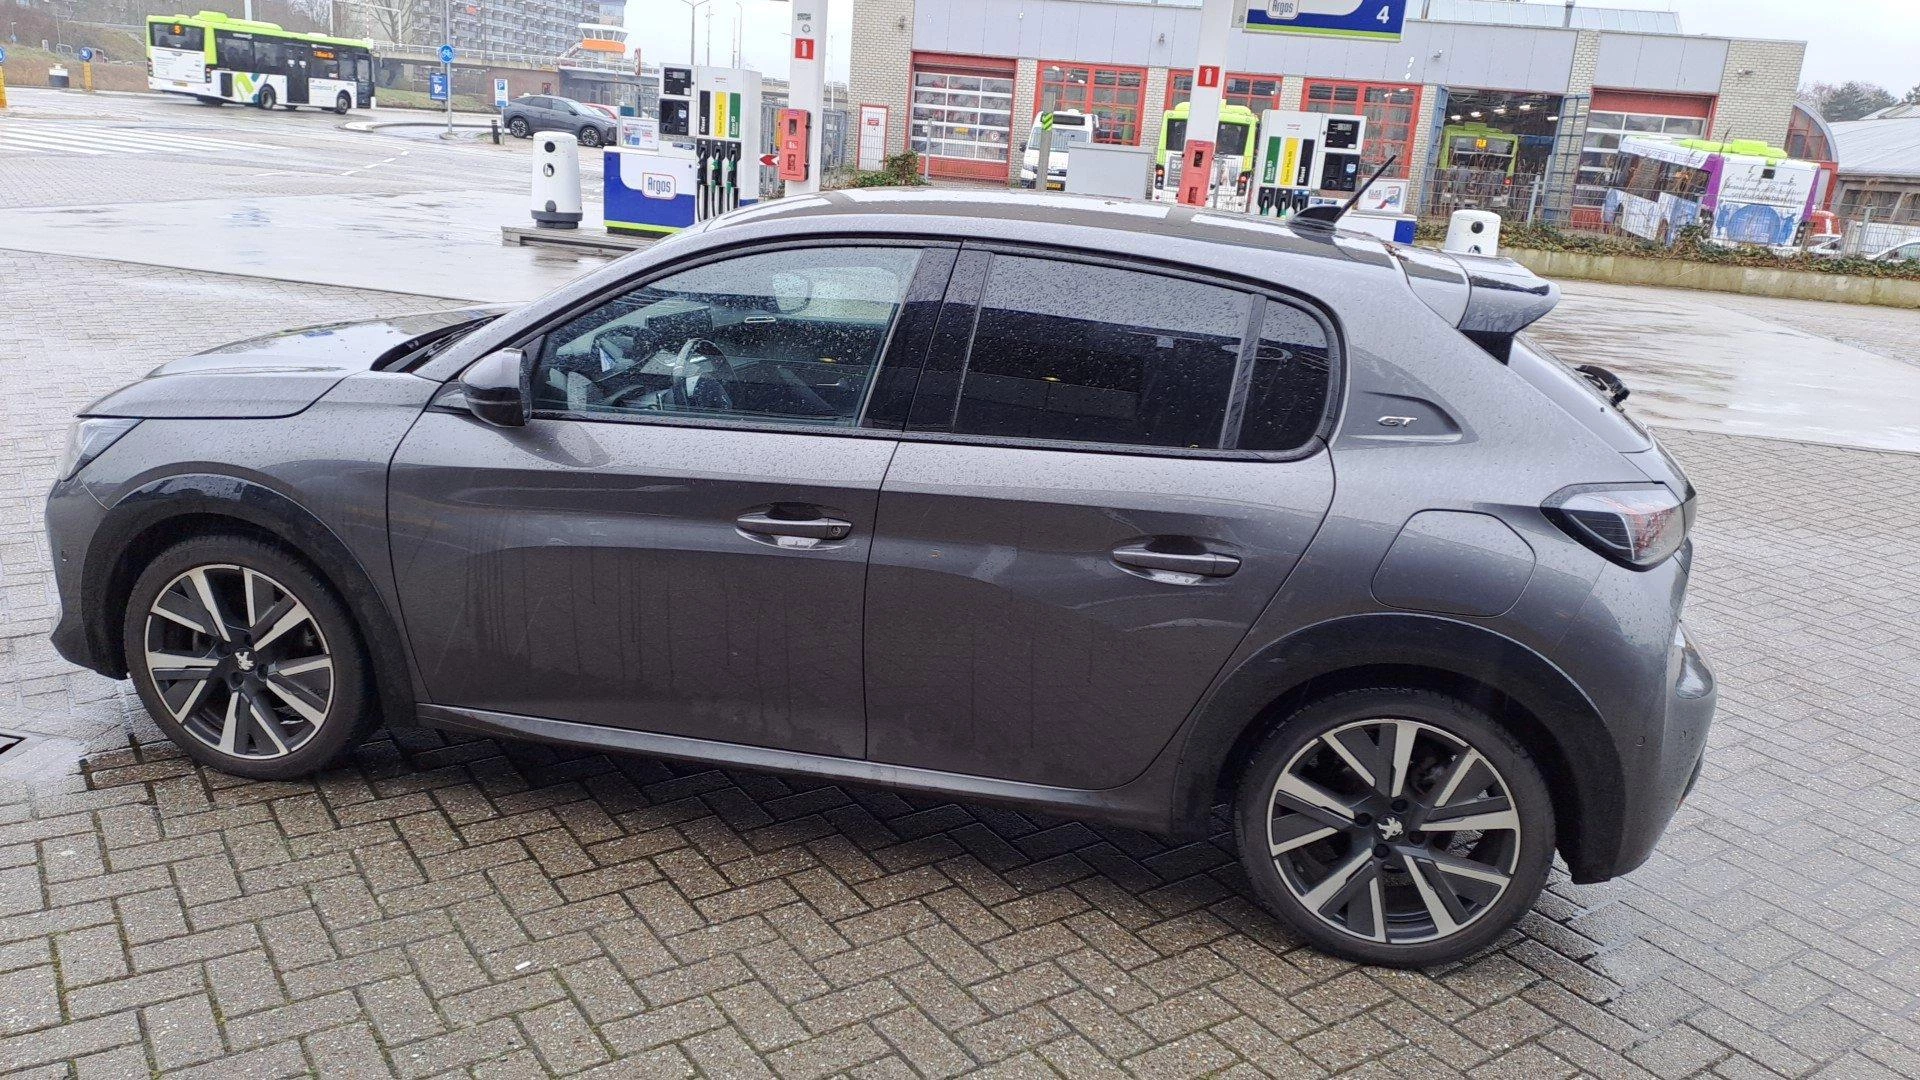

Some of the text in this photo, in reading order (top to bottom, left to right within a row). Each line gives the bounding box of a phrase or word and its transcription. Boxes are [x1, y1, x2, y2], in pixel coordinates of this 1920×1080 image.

[1271, 0, 1294, 15] Argos
[1376, 5, 1390, 24] 4
[647, 176, 671, 195] Argos
[1377, 415, 1418, 427] GT
